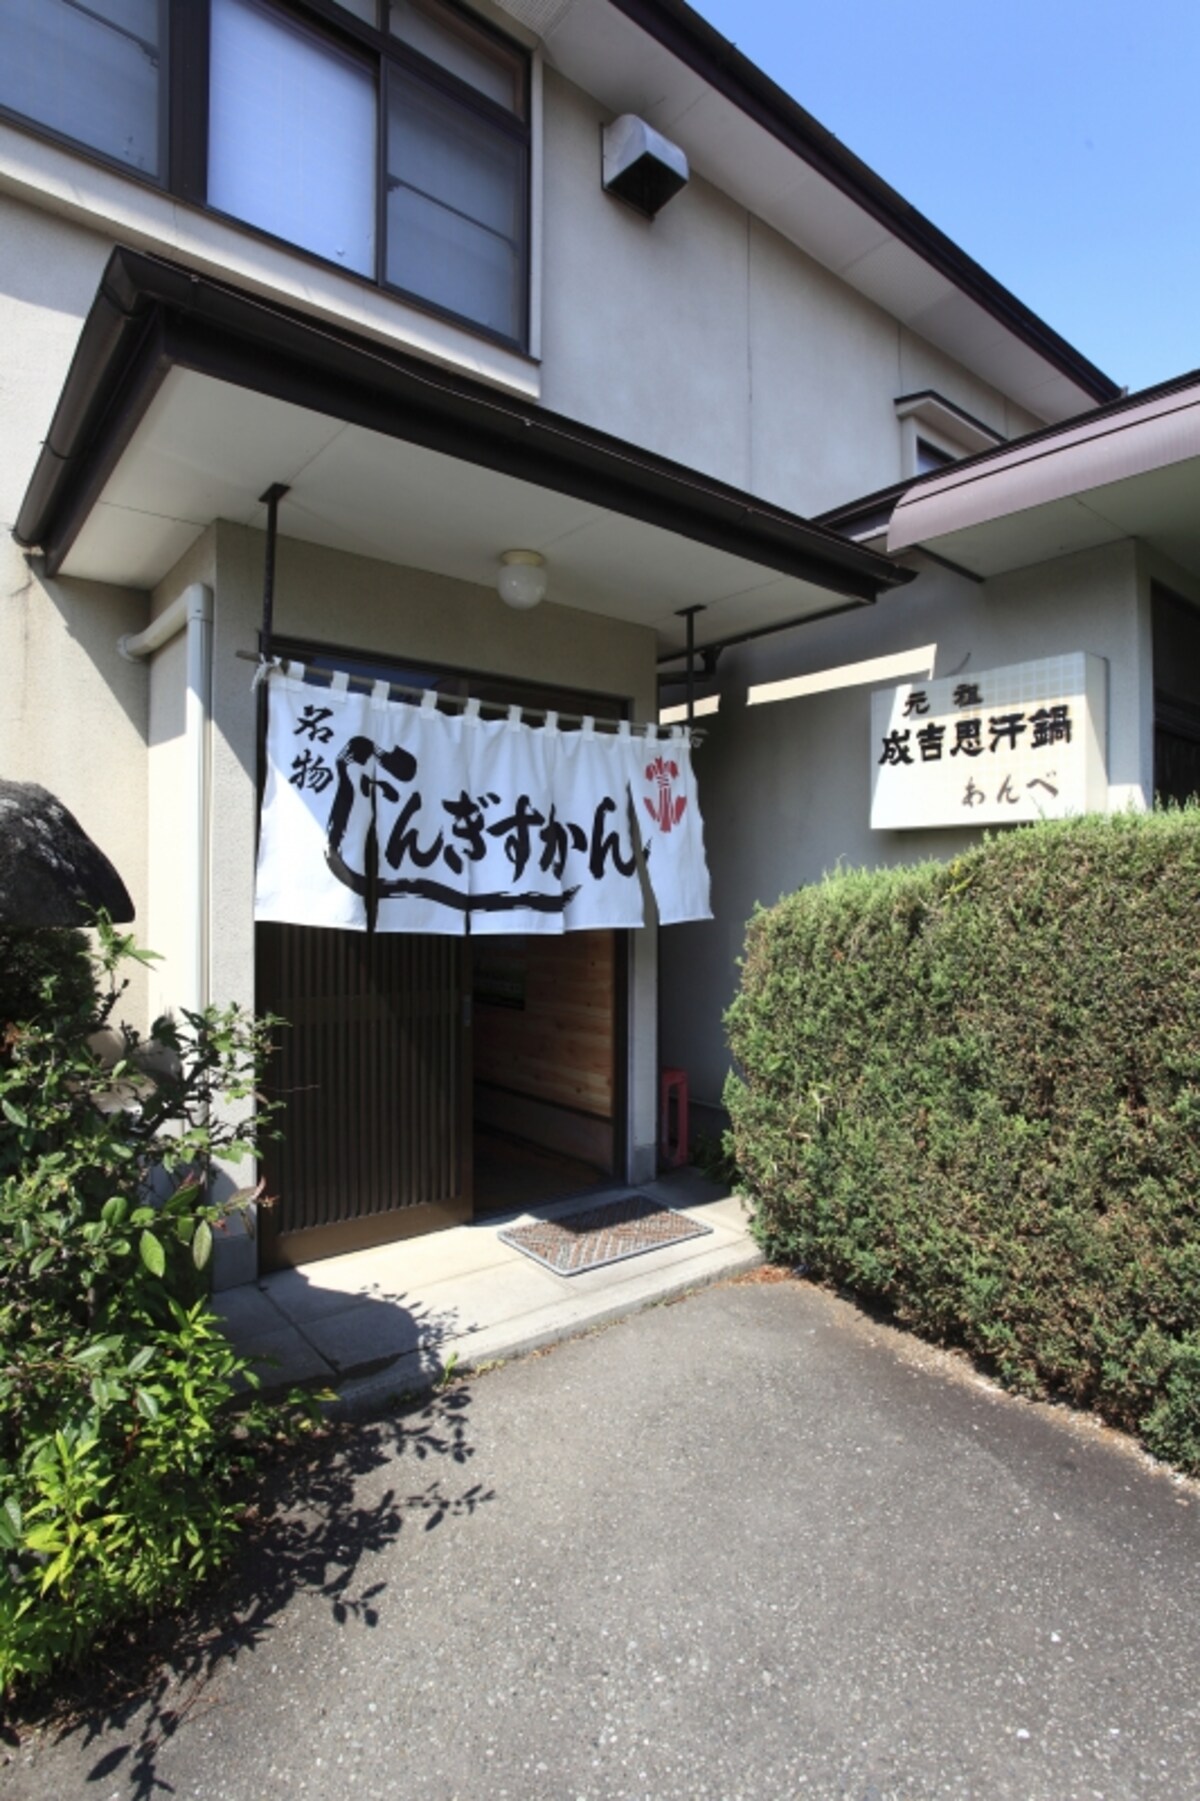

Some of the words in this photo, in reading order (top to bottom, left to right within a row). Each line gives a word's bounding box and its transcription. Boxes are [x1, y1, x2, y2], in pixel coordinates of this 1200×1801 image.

[902, 684, 983, 717] 元祖
[288, 704, 334, 794] 名物
[323, 736, 652, 912] じんぎすかん
